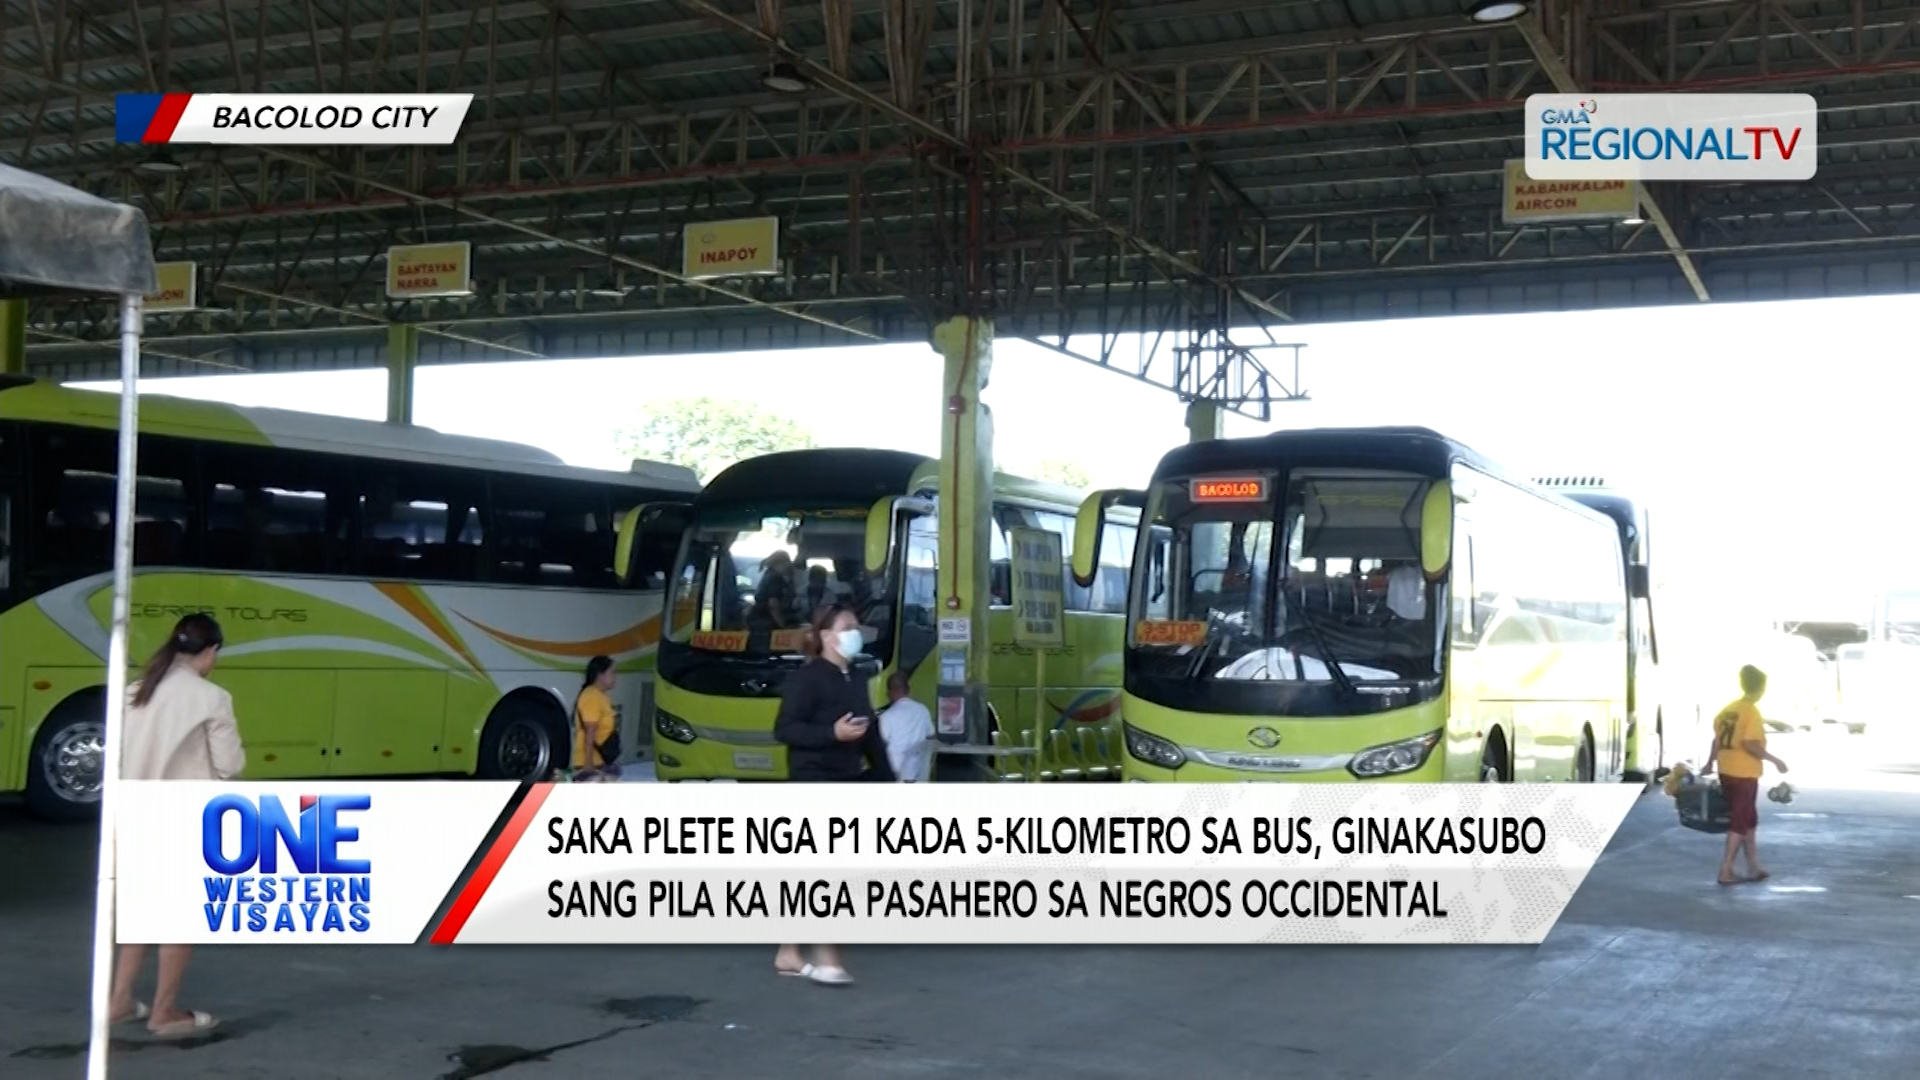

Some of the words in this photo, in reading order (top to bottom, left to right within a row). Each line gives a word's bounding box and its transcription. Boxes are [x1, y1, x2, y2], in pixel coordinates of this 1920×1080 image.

[1515, 180, 1625, 195] KABANKALAN
[1515, 198, 1577, 210] AIRCON
[700, 247, 758, 264] INAPOY
[1199, 483, 1259, 496] BACOLOD
[225, 607, 308, 622] TOURS
